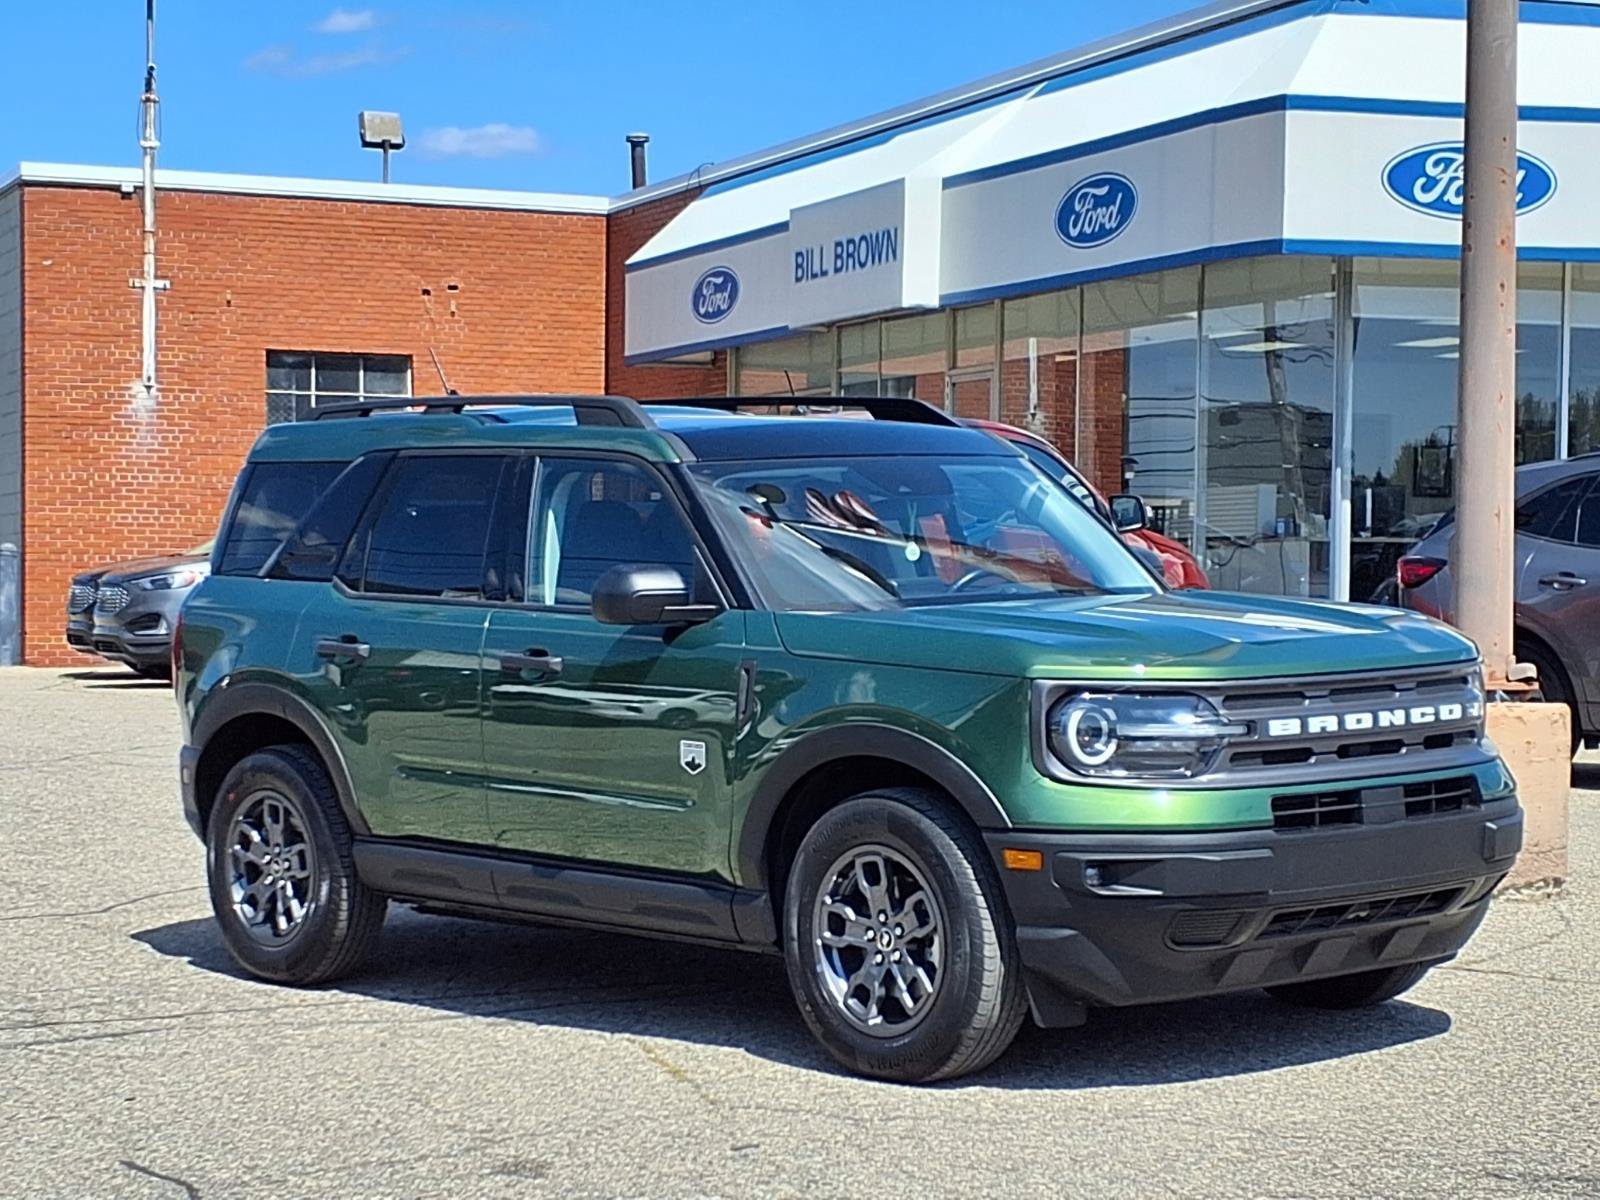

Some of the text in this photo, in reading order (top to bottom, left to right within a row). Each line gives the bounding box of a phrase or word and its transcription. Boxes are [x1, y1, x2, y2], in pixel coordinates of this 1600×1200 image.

[1069, 184, 1122, 237] Ford
[795, 227, 898, 283] BILL BROWN
[699, 276, 731, 315] Ford
[1268, 703, 1463, 737] BRONCO
